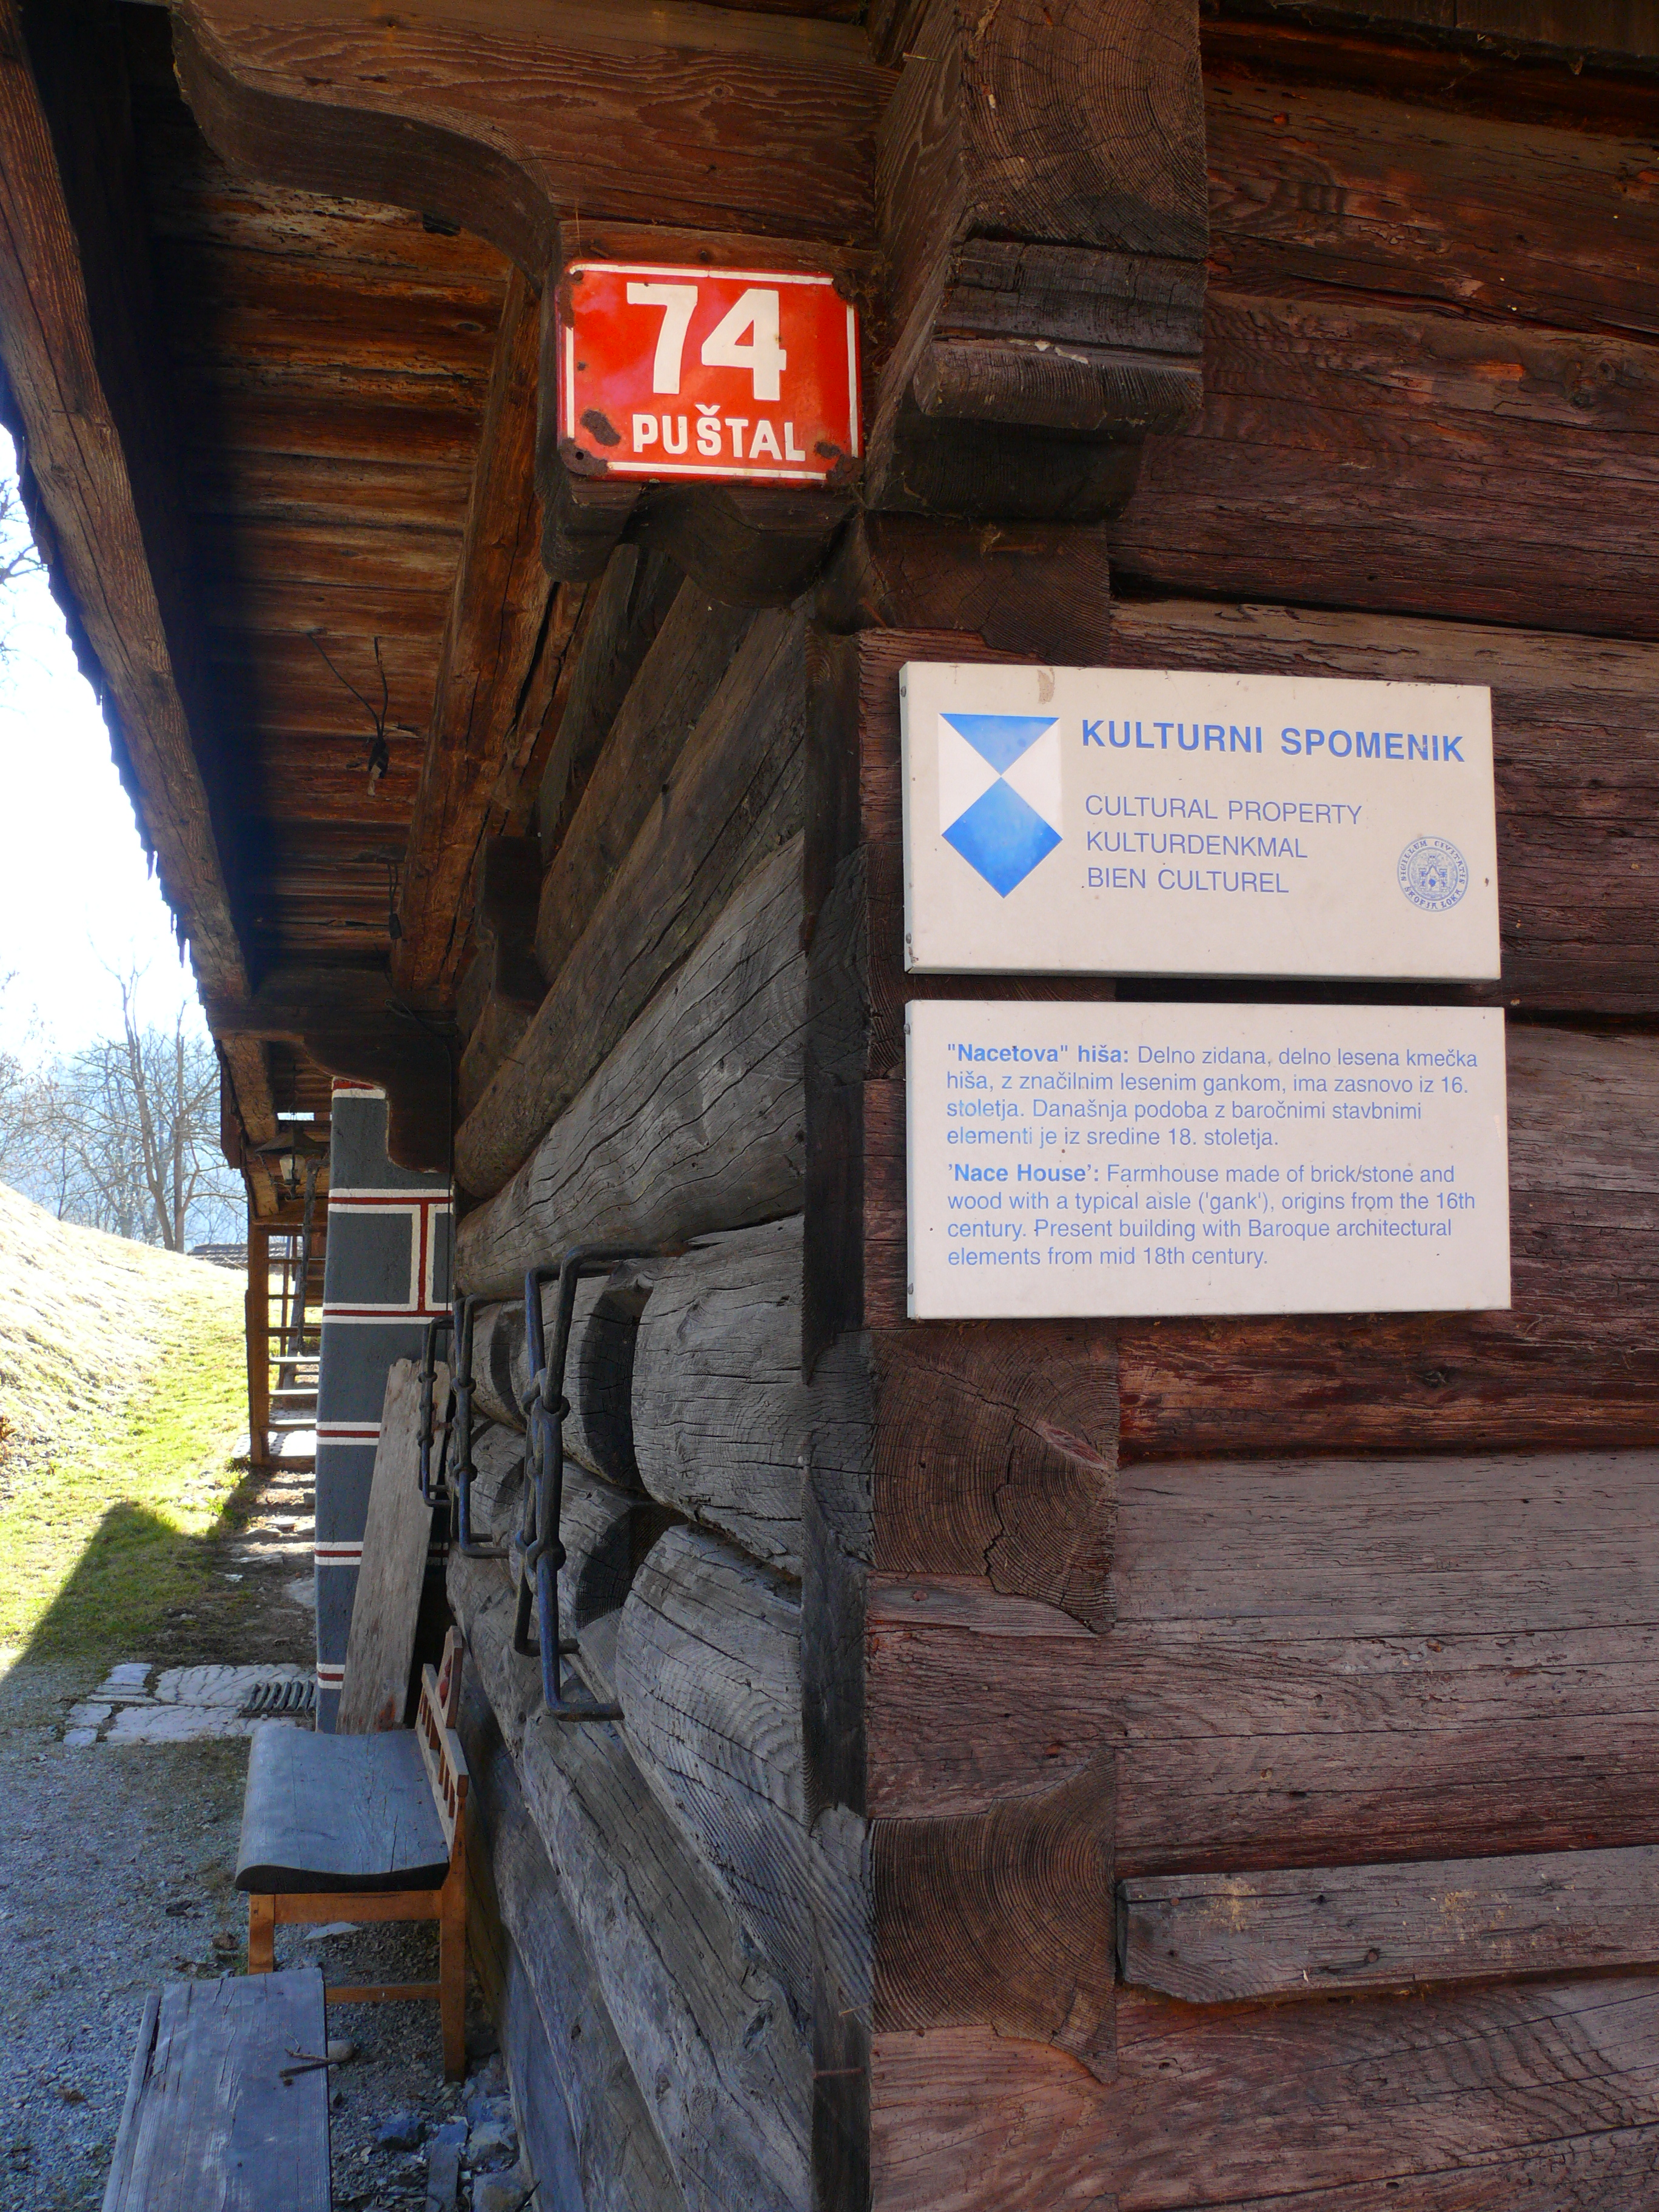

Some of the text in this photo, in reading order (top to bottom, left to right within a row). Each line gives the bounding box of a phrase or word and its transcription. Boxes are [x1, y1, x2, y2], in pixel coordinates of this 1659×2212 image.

[626, 282, 786, 401] 74
[632, 404, 805, 461] PUŠTAL
[1082, 718, 1466, 762] KULTURNI SPOMENIK
[1085, 793, 1362, 824] CULTURAL PROPERTY
[1087, 830, 1308, 858] KULTURDENKMAL
[1088, 866, 1289, 893] BIEN CULTUREL
[947, 1042, 1478, 1068] "Nacetova" hiša: Delno zidana, delno lesena kmečka
[947, 1070, 1469, 1096] hiša, z značilnim lesenim gankom, ima zasnovo iz 16.
[947, 1098, 1422, 1122] stoletja. Današnja podoba z baročnimi stavbnimi
[947, 1125, 1279, 1150] elementi je iz sredine 18. stoletja.
[1107, 1163, 1219, 1182] Farmhouse
[1226, 1165, 1280, 1182] made
[1286, 1164, 1304, 1182] of
[1311, 1165, 1414, 1182] brick/stone
[1420, 1164, 1455, 1182] and
[948, 1191, 1476, 1215] wood with a typical aisle ('gank'), origins from the 16th
[947, 1218, 1452, 1242] century. Present building with Baroque architectural
[947, 1245, 1269, 1269] elements from mid 18th century.
